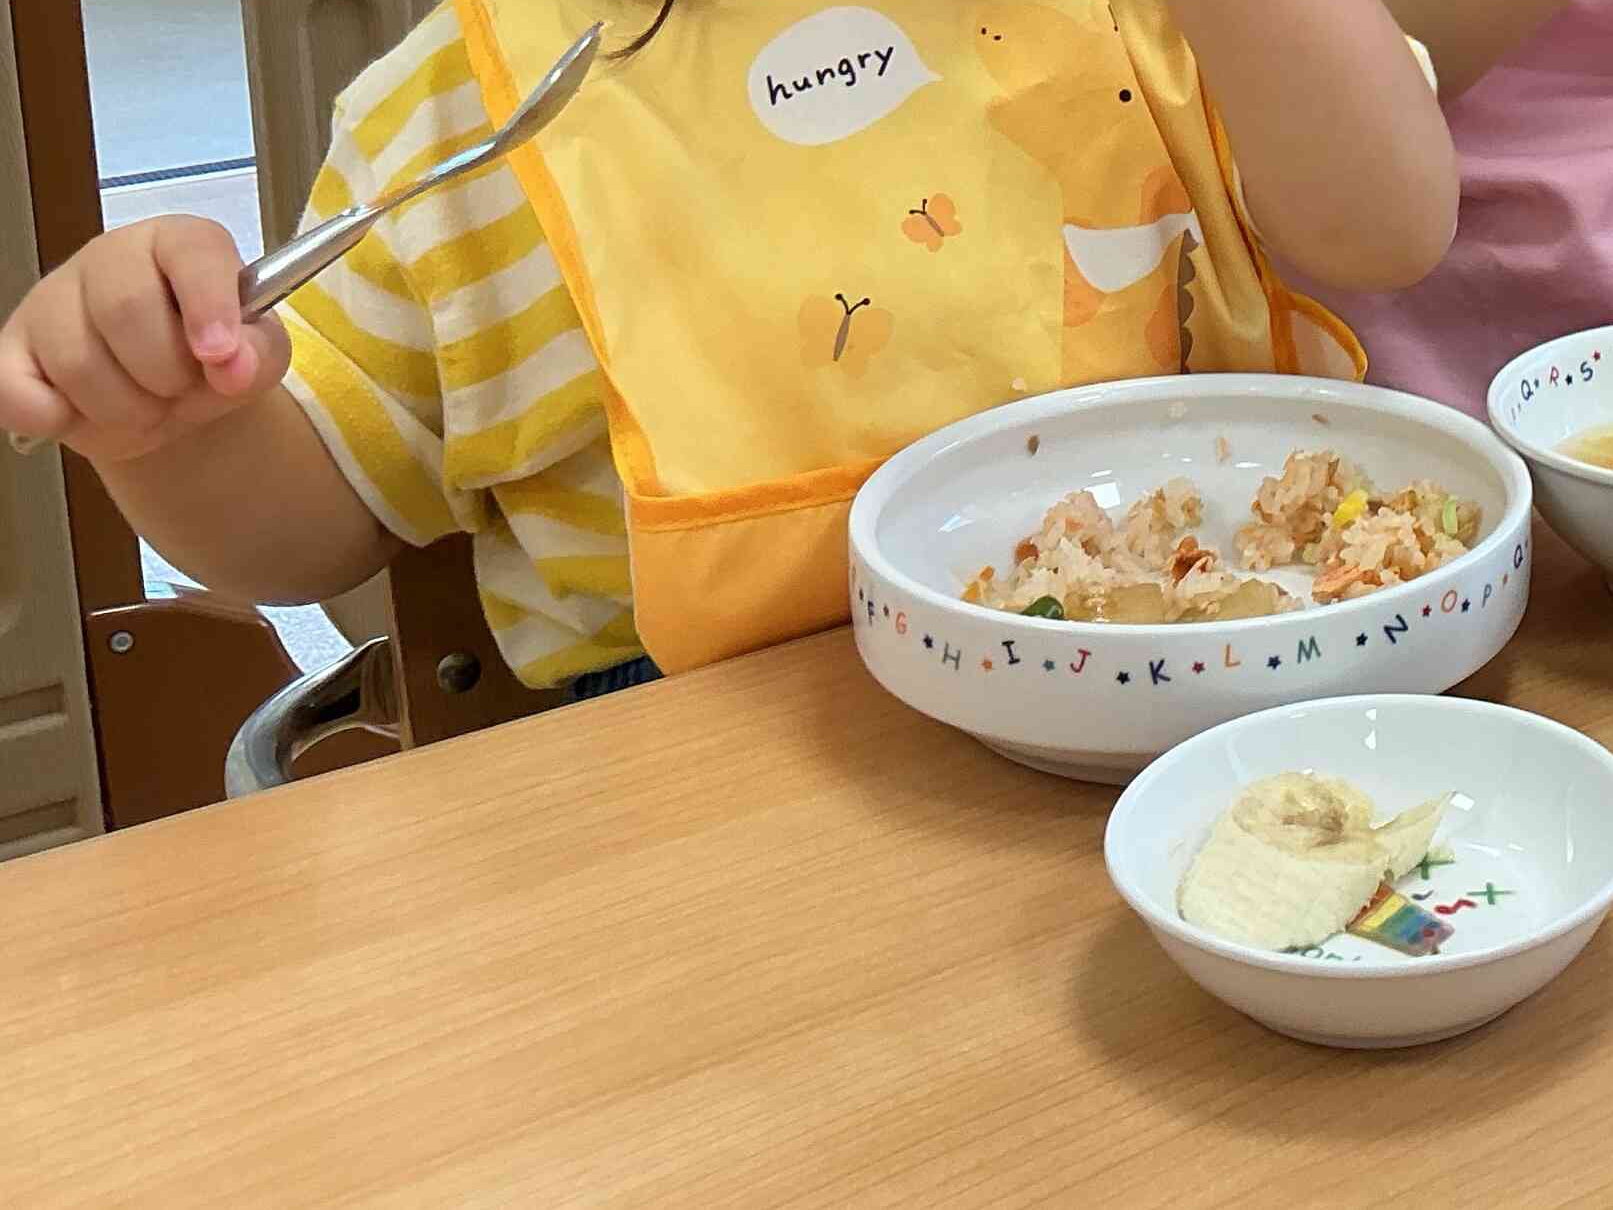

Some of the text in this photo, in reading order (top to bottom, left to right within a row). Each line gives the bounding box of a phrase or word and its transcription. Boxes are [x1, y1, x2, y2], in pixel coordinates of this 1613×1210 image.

[766, 46, 894, 106] hungry
[1521, 380, 1533, 400] Q
[1550, 367, 1559, 385] R
[1580, 362, 1593, 381] S
[896, 612, 906, 634] G
[942, 643, 960, 670] H
[1002, 641, 1020, 664] I
[1070, 650, 1091, 672] J
[1149, 660, 1170, 684] K
[1224, 644, 1240, 667] L
[1298, 637, 1320, 663] M
[1384, 614, 1408, 643] N
[1441, 590, 1457, 612] O
[1482, 584, 1492, 607] P
[1514, 545, 1523, 569] Q
